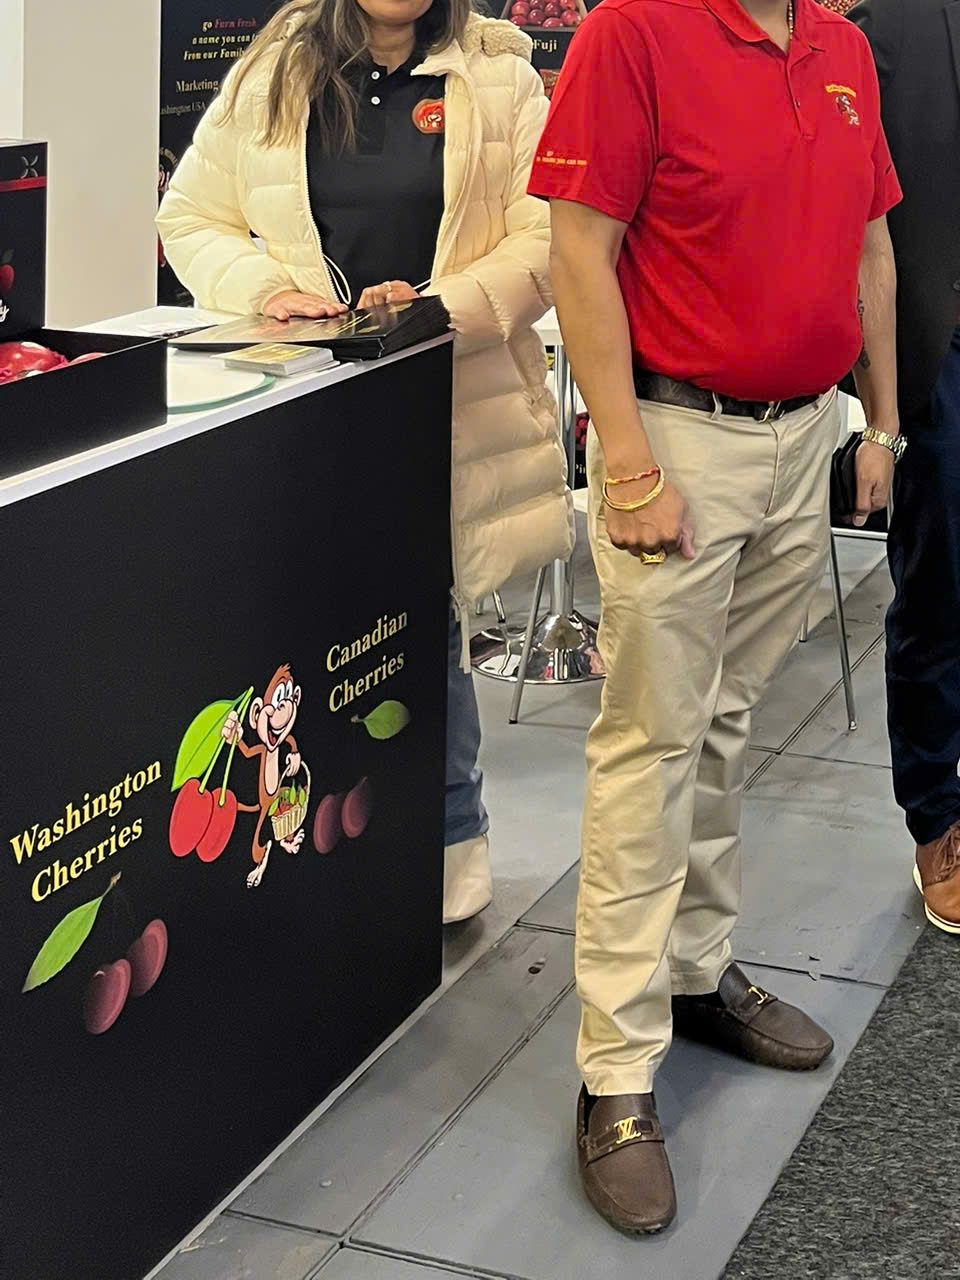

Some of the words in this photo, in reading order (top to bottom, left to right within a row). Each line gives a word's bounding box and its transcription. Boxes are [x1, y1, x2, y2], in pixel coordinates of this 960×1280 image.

[202, 21, 213, 32] go
[198, 36, 220, 44] name
[221, 35, 236, 47] you
[237, 35, 251, 43] can
[533, 39, 557, 53] Fuji
[203, 51, 218, 59] our
[176, 79, 219, 92] Marketing
[160, 105, 191, 116] ashington
[192, 101, 206, 112] USA
[326, 609, 408, 673] Canadian
[329, 649, 405, 713] Cherries
[9, 759, 162, 866] Washington
[31, 816, 143, 904] Cherries
